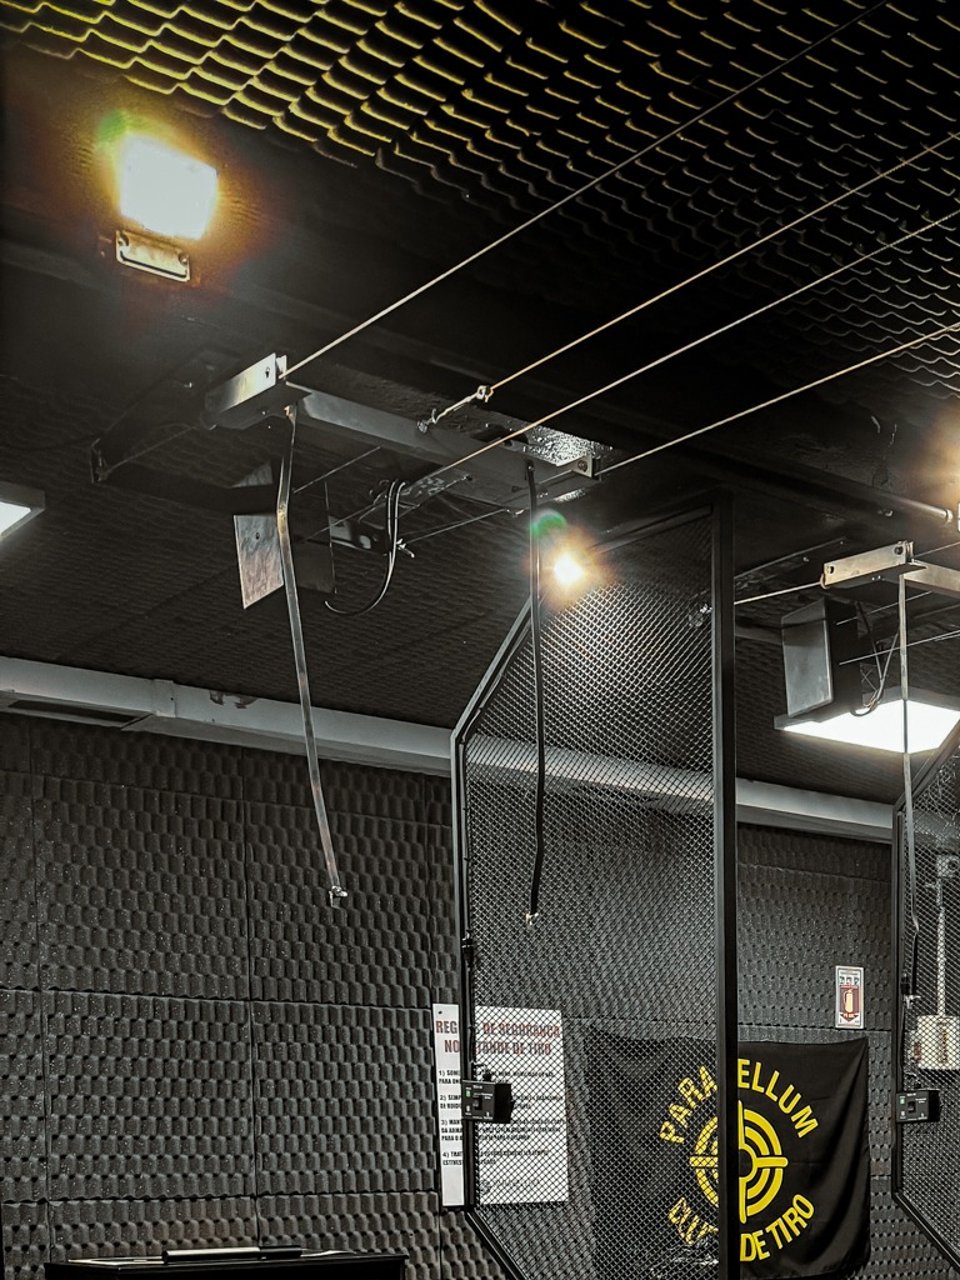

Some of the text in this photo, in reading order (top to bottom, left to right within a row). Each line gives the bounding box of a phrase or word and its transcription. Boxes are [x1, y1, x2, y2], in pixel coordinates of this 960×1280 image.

[660, 1058, 818, 1144] PARAELLUM
[739, 1230, 770, 1262] DE
[765, 1194, 815, 1250] TIRO
